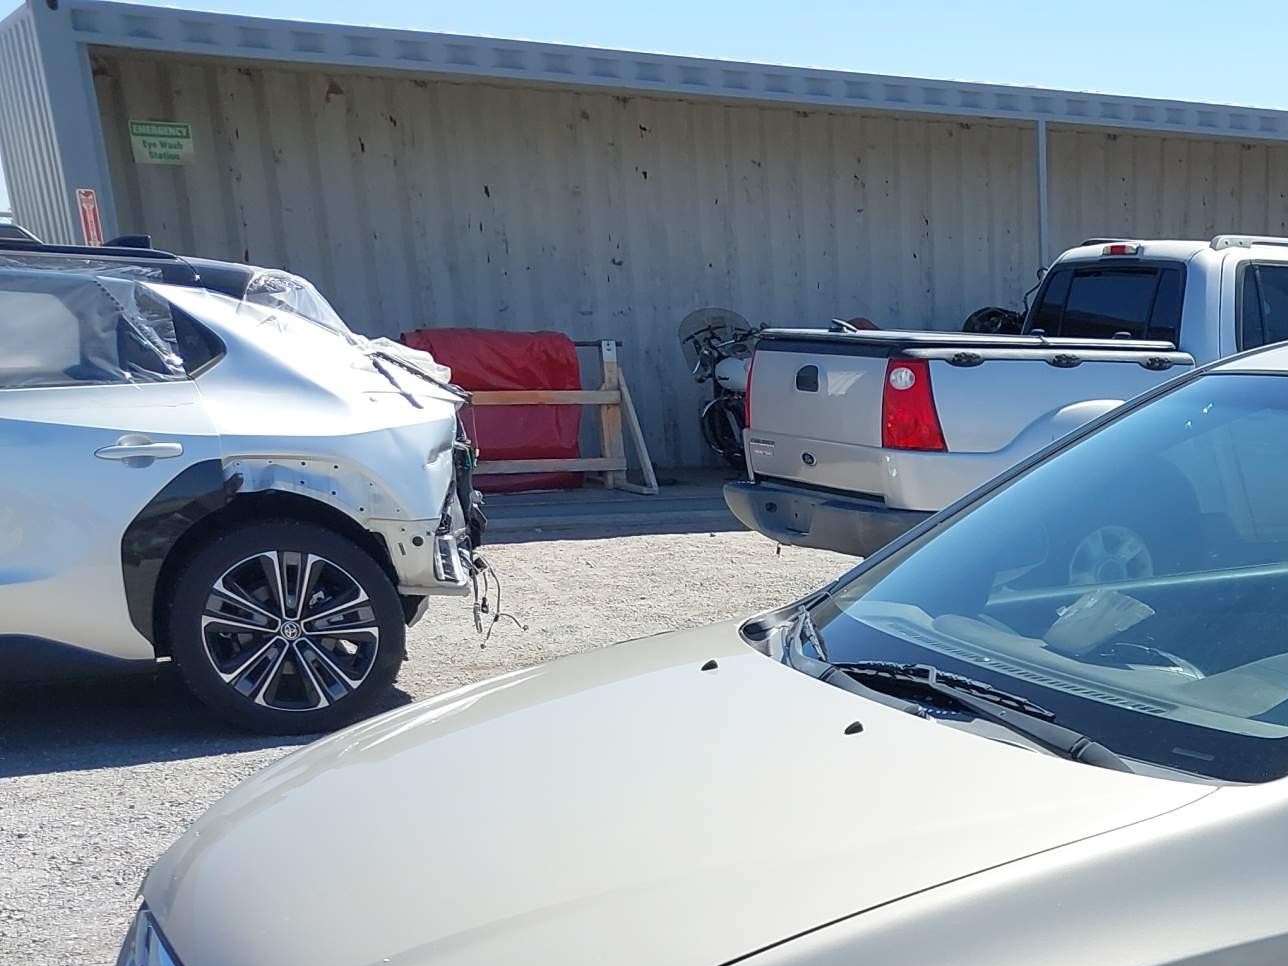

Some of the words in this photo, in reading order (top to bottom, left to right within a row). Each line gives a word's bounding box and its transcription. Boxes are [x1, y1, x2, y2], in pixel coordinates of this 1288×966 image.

[142, 140, 157, 150] Eye
[160, 141, 183, 150] Wash
[149, 151, 180, 160] Station
